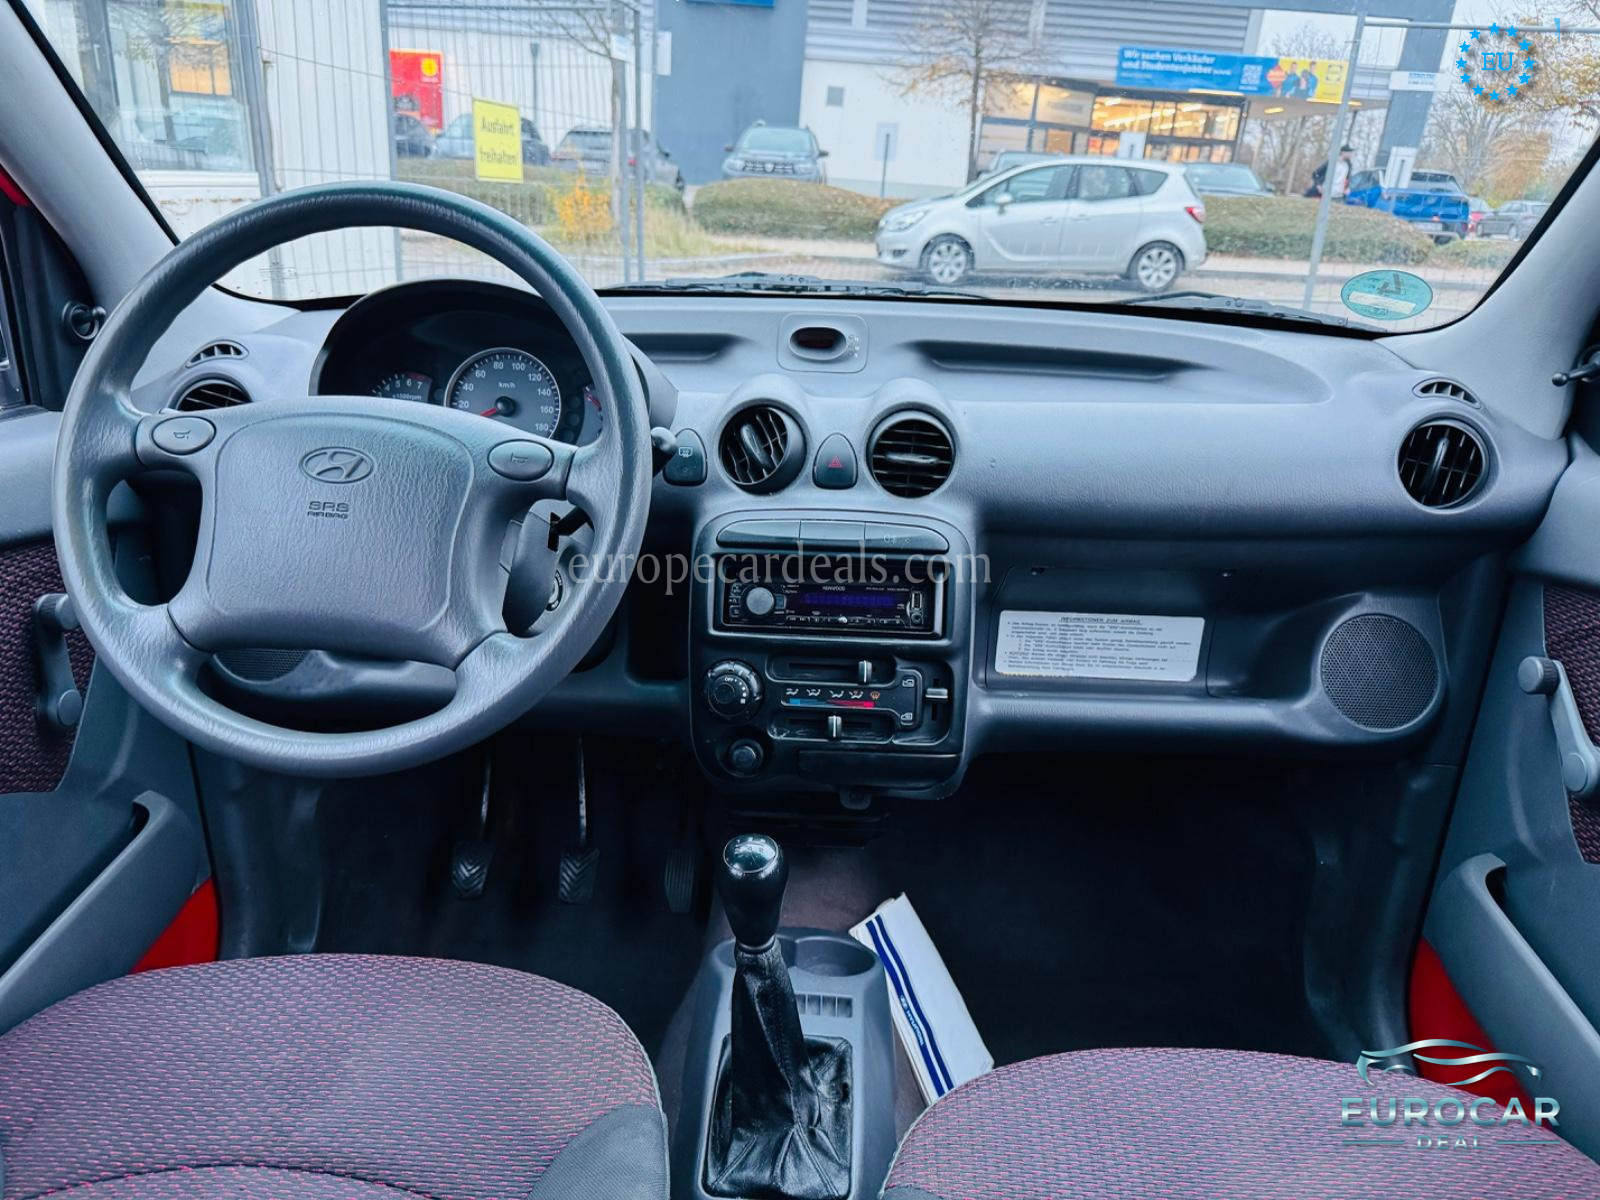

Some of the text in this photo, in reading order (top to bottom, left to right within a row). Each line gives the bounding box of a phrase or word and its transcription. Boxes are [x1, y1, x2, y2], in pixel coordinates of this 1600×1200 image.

[1123, 48, 1216, 64] Wir suchen Verkäufer
[1121, 60, 1140, 69] und
[493, 361, 504, 370] 80
[511, 362, 526, 371] 100
[475, 370, 486, 378] 60
[528, 373, 542, 382] 120
[406, 378, 412, 387] 6
[417, 381, 423, 389] 7
[498, 381, 516, 389] km/h
[463, 383, 474, 391] 40
[537, 388, 551, 396] 140
[458, 400, 469, 408] 20
[540, 406, 554, 414] 160
[535, 423, 549, 431] 180
[308, 500, 350, 512] SRS
[307, 511, 349, 519] AIRBAG
